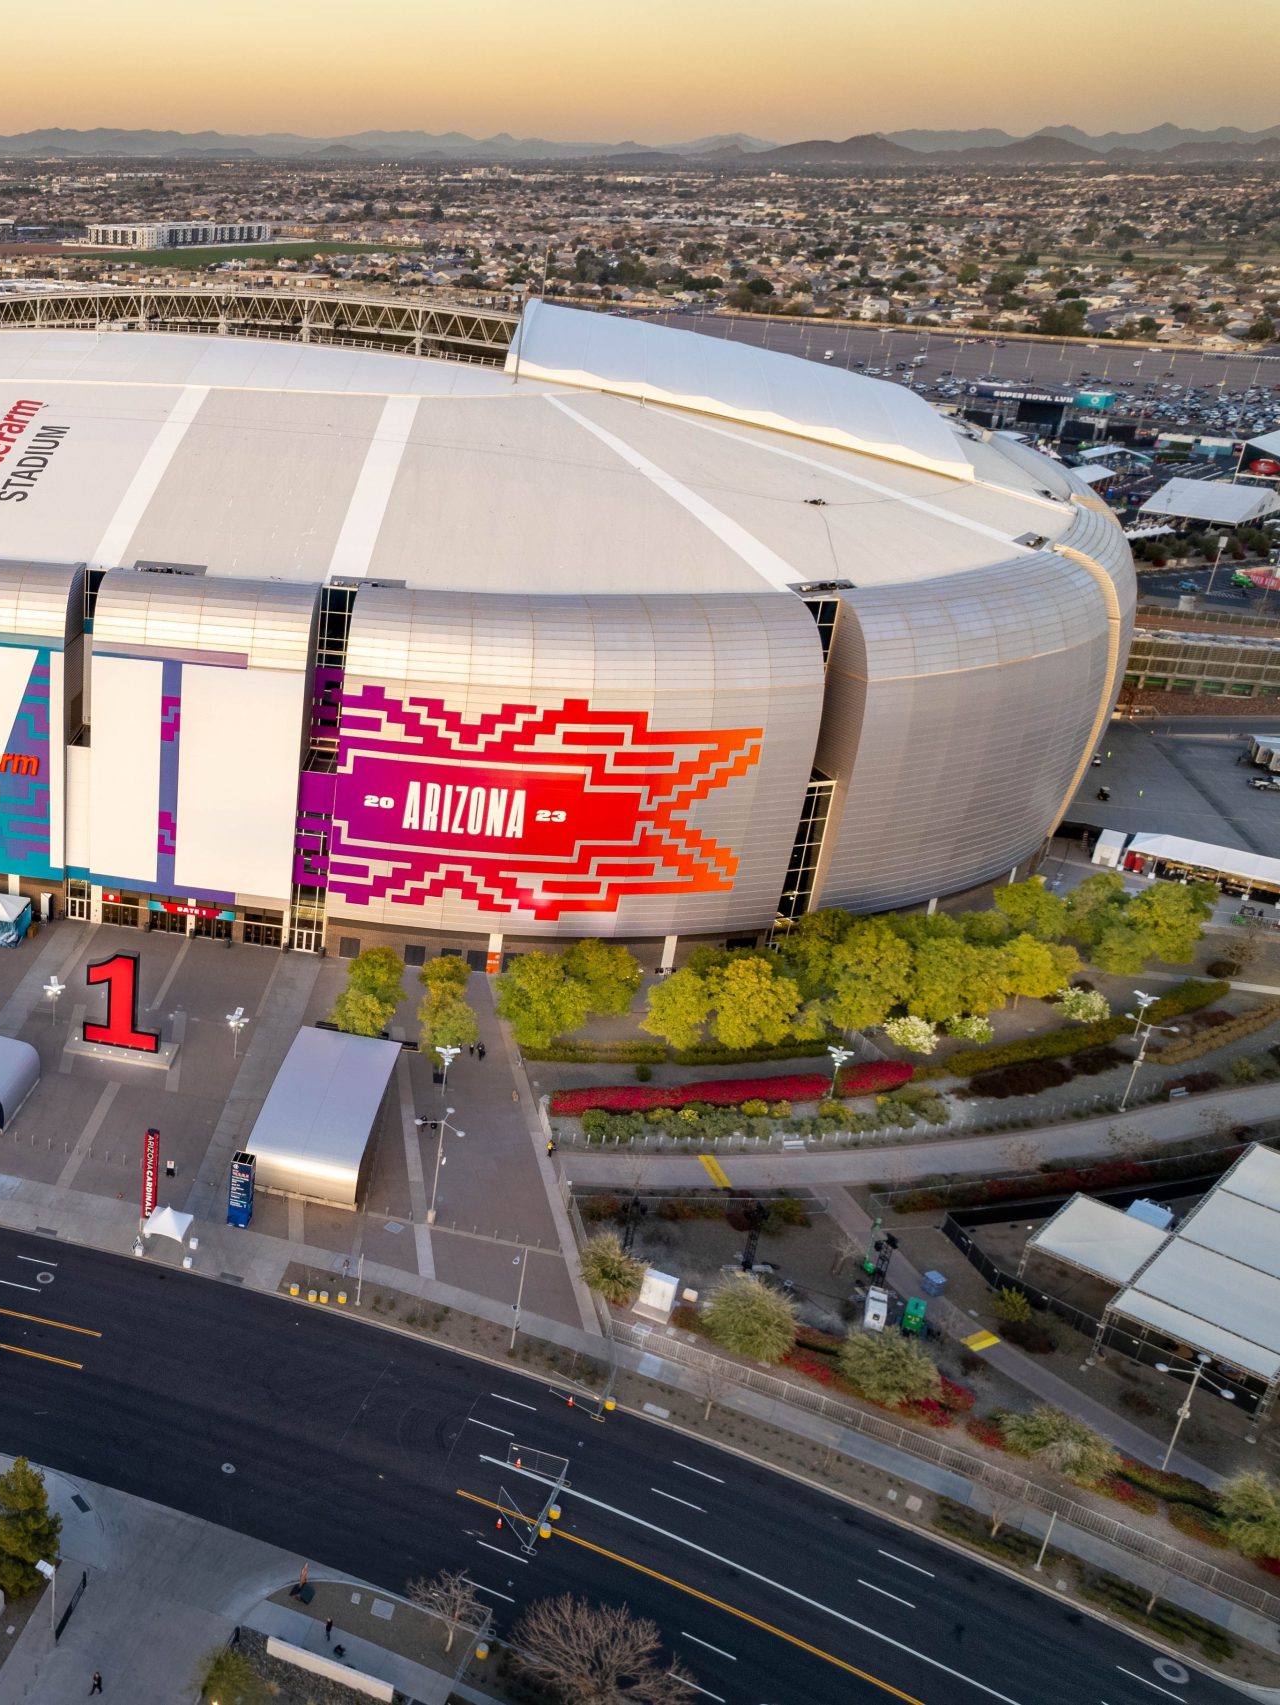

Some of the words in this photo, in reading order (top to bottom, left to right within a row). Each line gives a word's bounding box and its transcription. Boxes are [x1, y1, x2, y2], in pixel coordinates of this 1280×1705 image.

[993, 390, 1024, 400] SUPER
[1026, 393, 1052, 402] BOWL
[1054, 395, 1074, 404] LVII
[364, 794, 394, 809] 20
[402, 780, 526, 839] ARIZONA
[535, 810, 567, 822] 23
[176, 906, 200, 914] GATE
[83, 949, 161, 1054] 1
